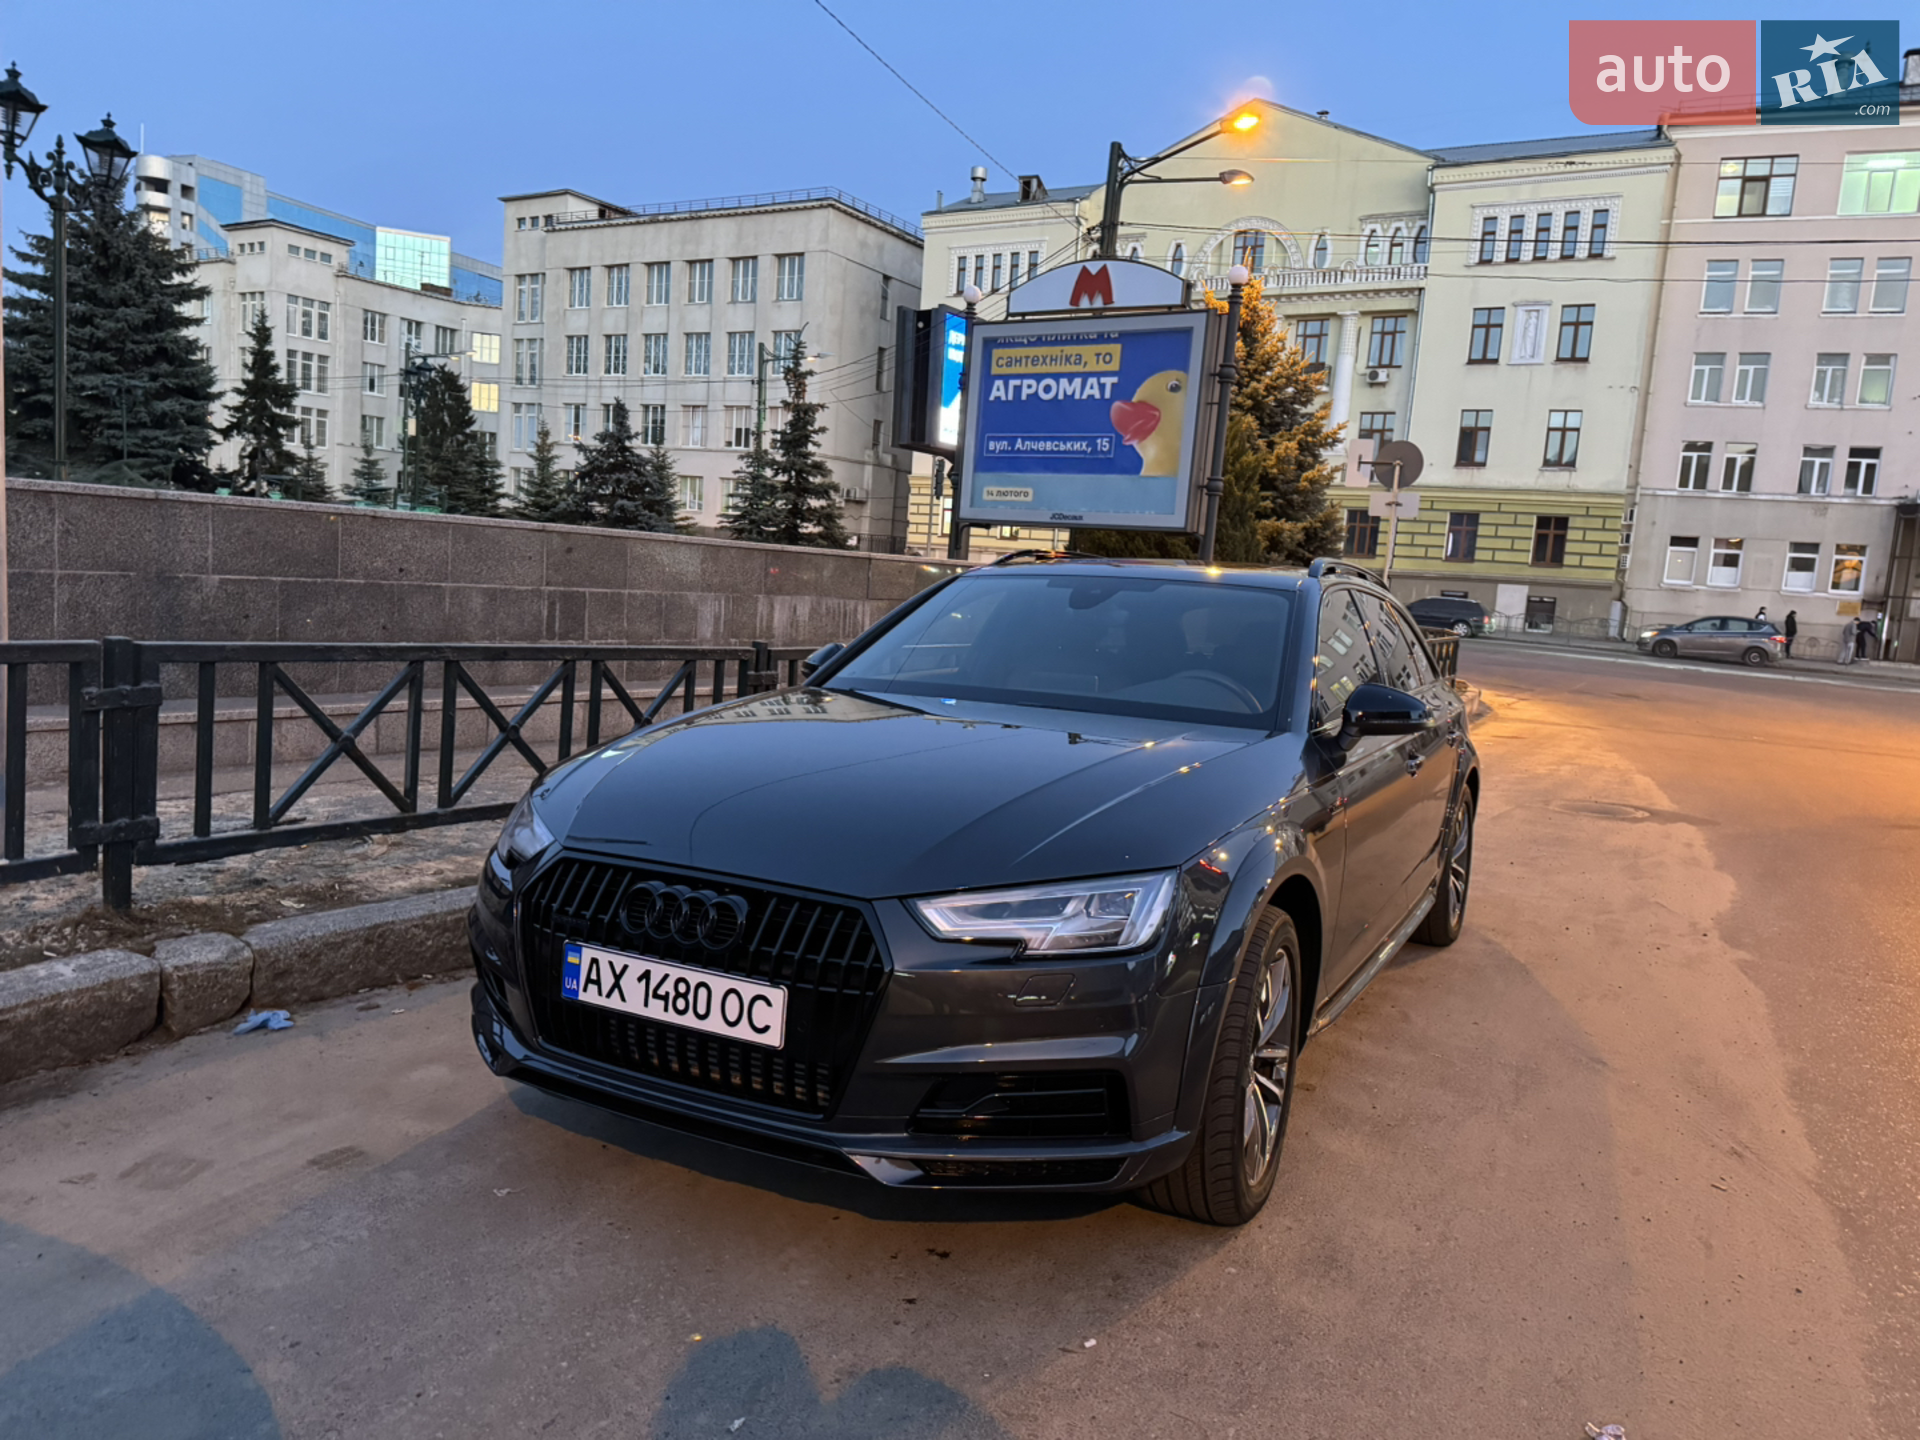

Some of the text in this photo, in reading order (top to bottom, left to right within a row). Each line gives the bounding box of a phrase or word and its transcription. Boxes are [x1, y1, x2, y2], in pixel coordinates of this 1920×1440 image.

[995, 349, 1113, 369] сантехніка, то
[989, 377, 1119, 401] АГРОМАТ
[988, 438, 1110, 454] вул. Алчевських, 15
[564, 976, 578, 991] UA
[582, 957, 773, 1034] AX 1480 OC
